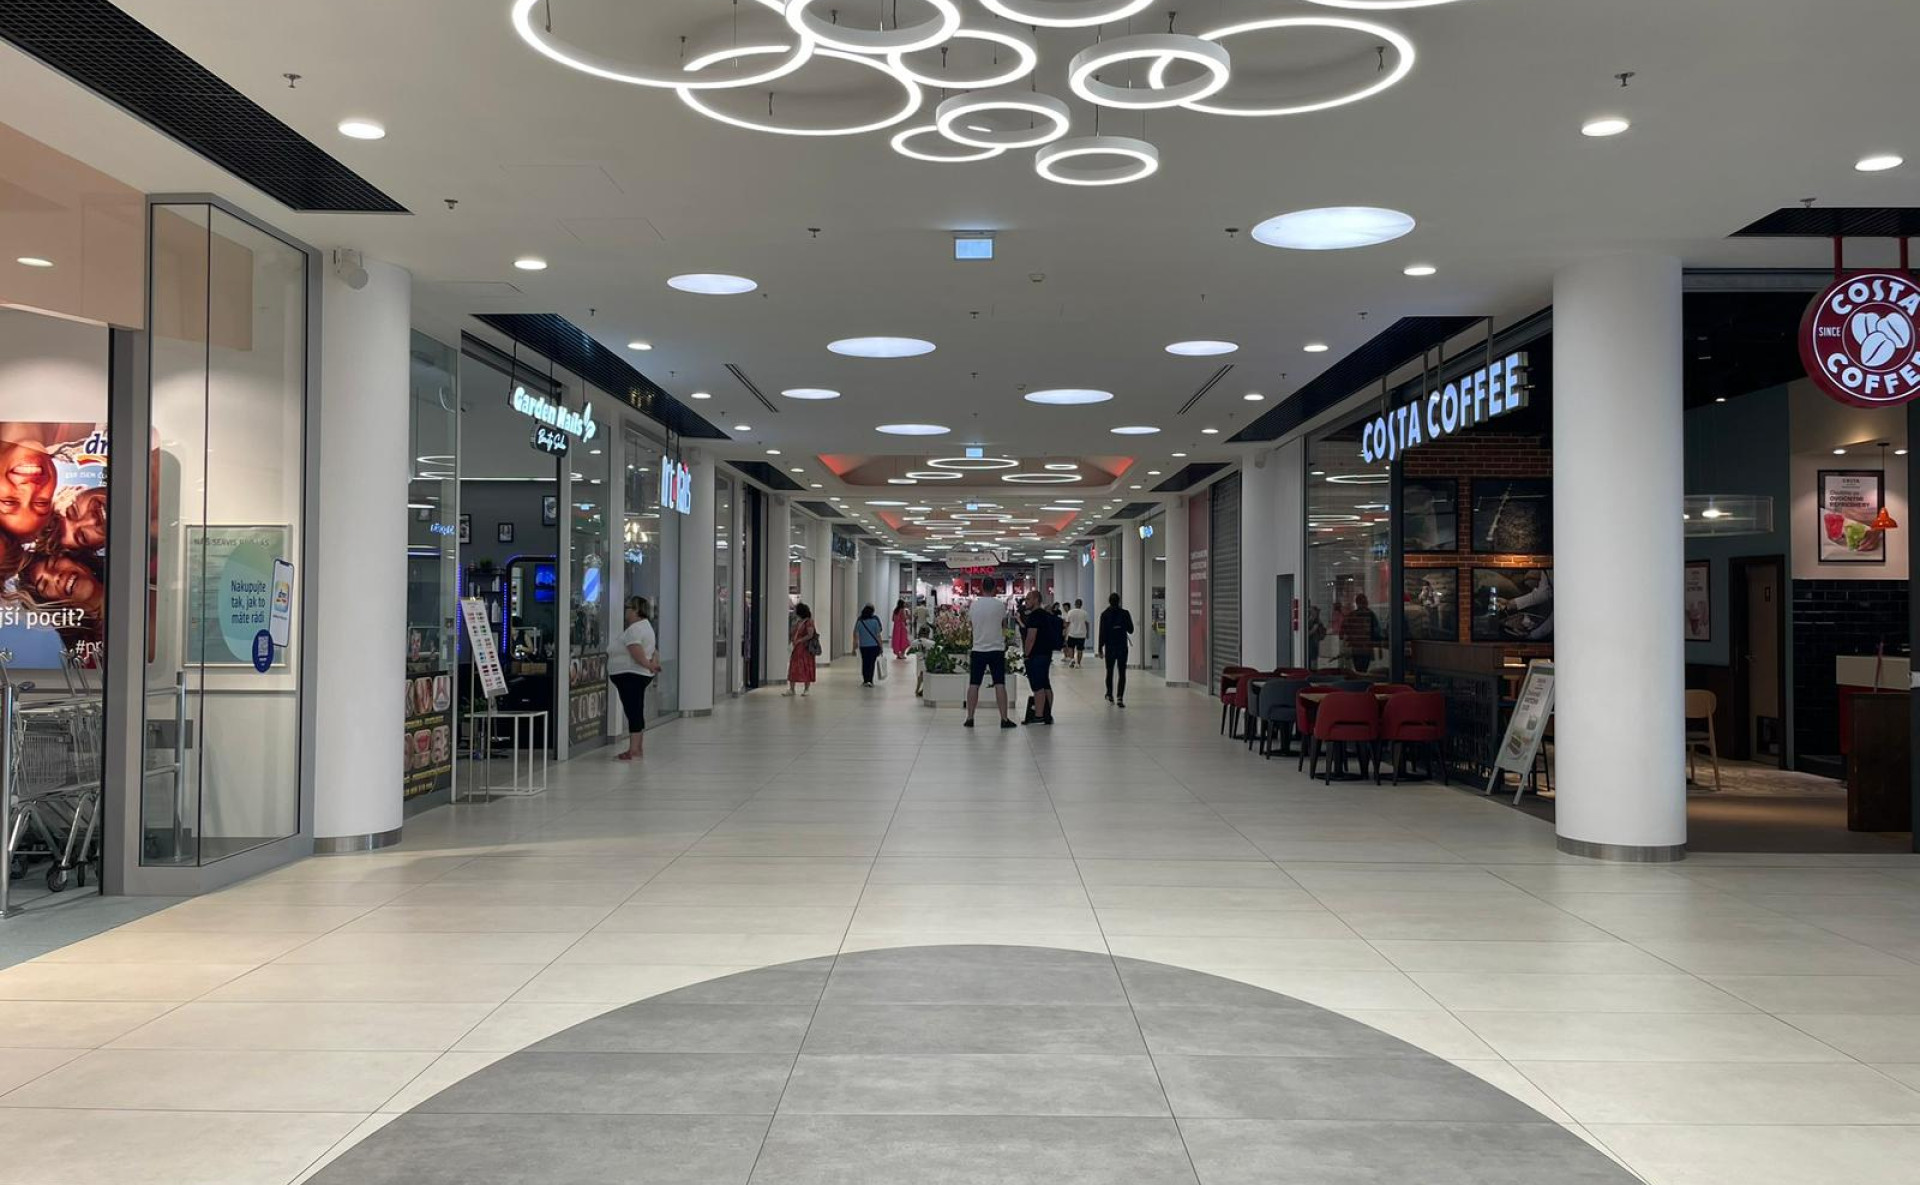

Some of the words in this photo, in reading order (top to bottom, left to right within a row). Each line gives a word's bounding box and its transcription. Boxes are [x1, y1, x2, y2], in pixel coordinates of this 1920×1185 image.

[1831, 279, 1920, 316] COSTA
[1818, 326, 1841, 338] SINCE
[513, 387, 557, 426] Garden
[556, 405, 583, 436] Nails
[1362, 400, 1422, 464] COSTA
[1427, 352, 1522, 439] COFFEE
[231, 579, 266, 595] Nakupujte
[231, 597, 244, 610] tak,
[246, 597, 257, 610] jak
[258, 598, 266, 608] to
[26, 608, 85, 629] pocit?
[231, 612, 250, 624] máte
[251, 611, 265, 624] rádi
[76, 639, 104, 659] #pr
